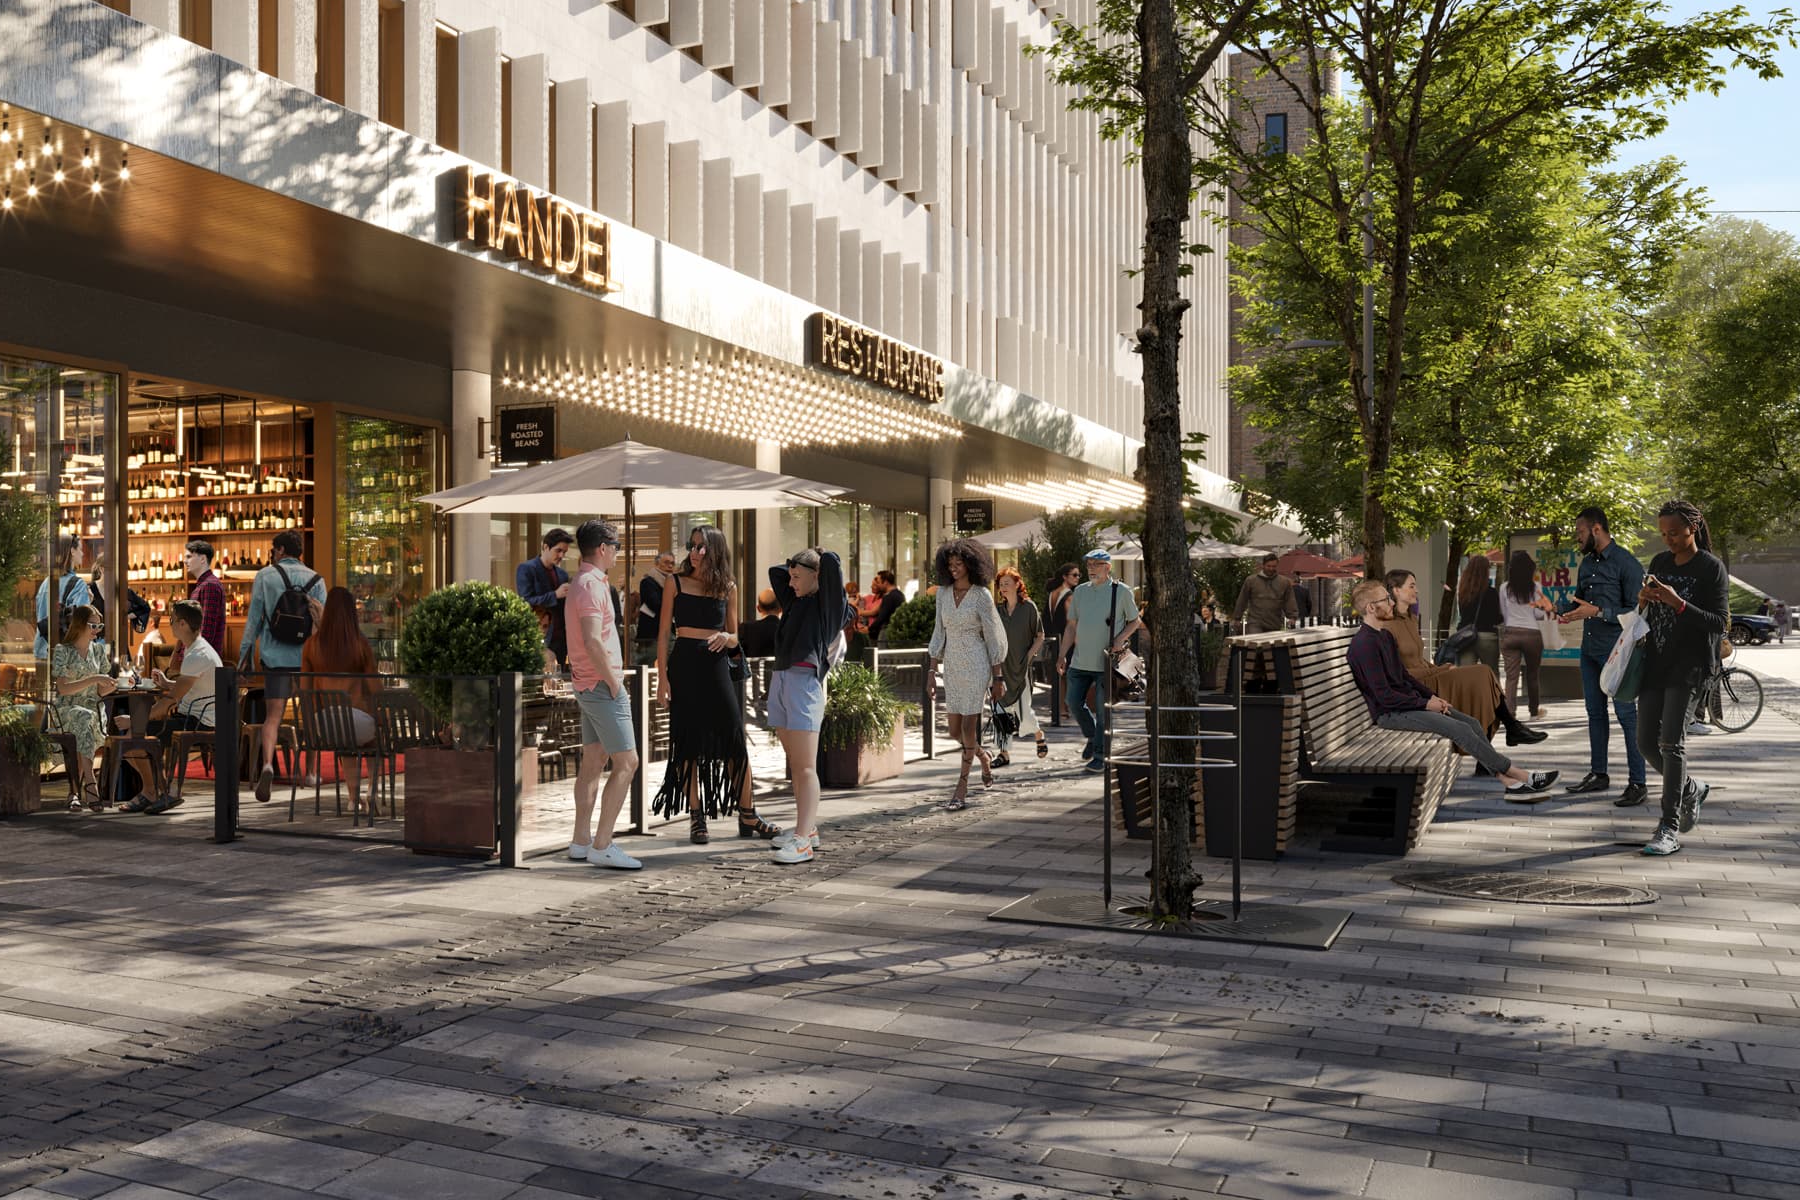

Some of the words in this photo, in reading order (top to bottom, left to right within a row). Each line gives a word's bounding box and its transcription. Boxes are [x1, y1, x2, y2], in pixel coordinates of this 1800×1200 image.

[464, 165, 623, 292] HANDEL
[821, 312, 945, 404] RESTAURANG
[516, 422, 538, 430] FRESH
[511, 430, 544, 439] ROASTED
[515, 439, 540, 448] BEANS
